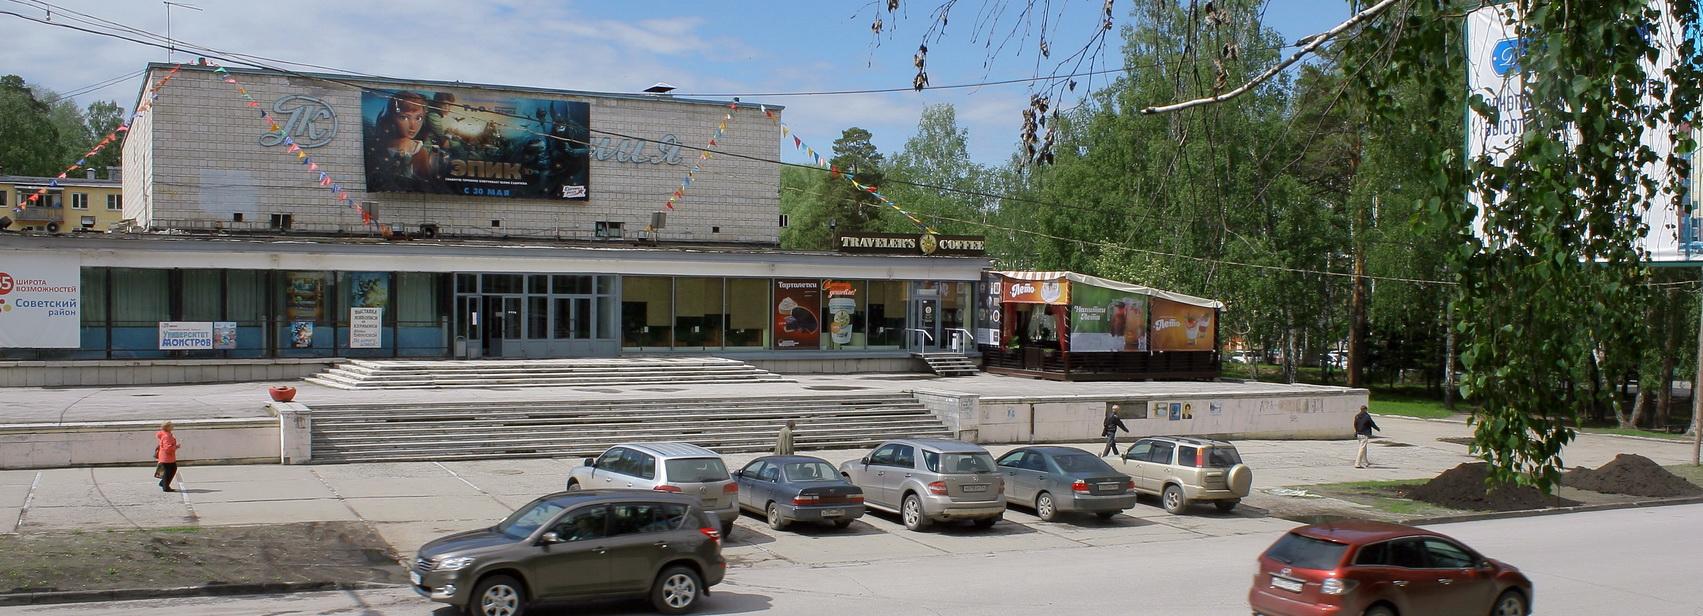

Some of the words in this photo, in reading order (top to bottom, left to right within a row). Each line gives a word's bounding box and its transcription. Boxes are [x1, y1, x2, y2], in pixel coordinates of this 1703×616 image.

[451, 159, 522, 179] ЭПИК
[841, 236, 916, 249] TRAVELER'S
[939, 239, 985, 251] COFFEE
[777, 281, 818, 290] Тарталетки
[1011, 283, 1035, 298] Лето
[15, 298, 77, 308] Советский
[48, 308, 76, 317] район
[1155, 318, 1181, 331] Лето
[162, 338, 211, 347] МОНСТРОВ
